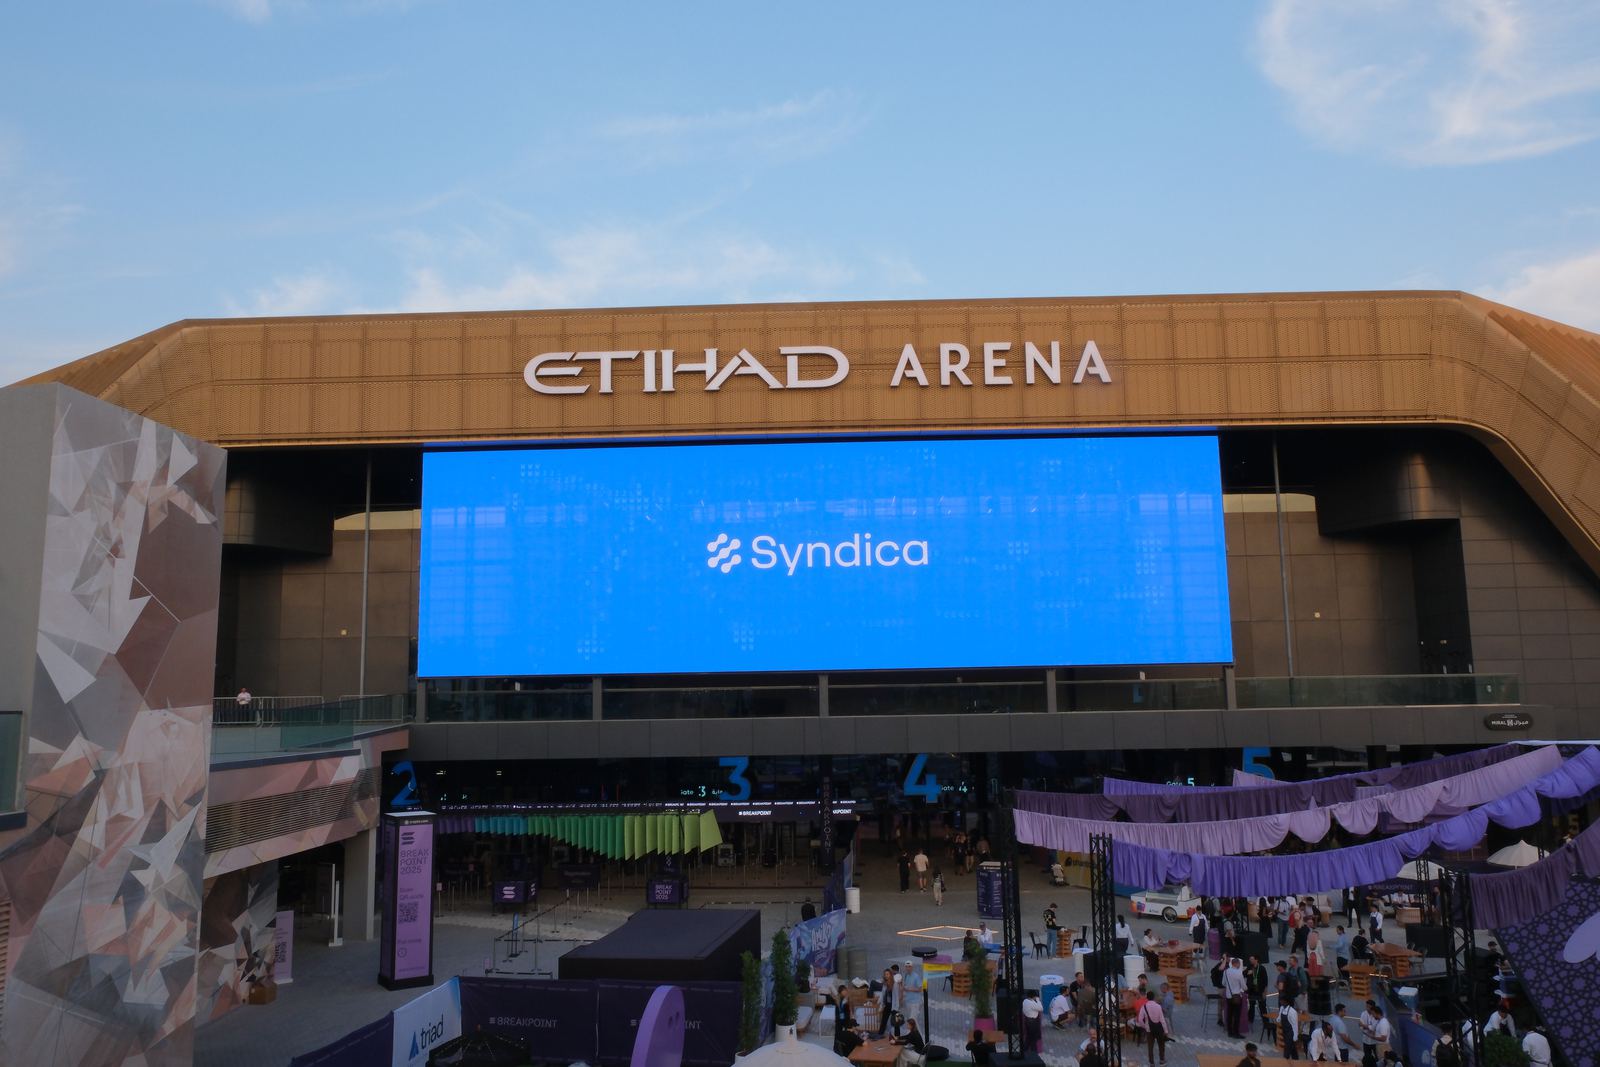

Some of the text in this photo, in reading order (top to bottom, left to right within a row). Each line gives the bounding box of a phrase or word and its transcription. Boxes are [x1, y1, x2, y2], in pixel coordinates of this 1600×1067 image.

[523, 339, 1112, 394] ETIHAD ARENA
[751, 532, 930, 576] Syndica
[390, 760, 421, 806] 2
[720, 755, 752, 801] 3
[904, 752, 942, 804] 4
[1242, 747, 1275, 780] 5
[420, 1013, 444, 1050] triad
[497, 1016, 559, 1029] BREAKPOINT
